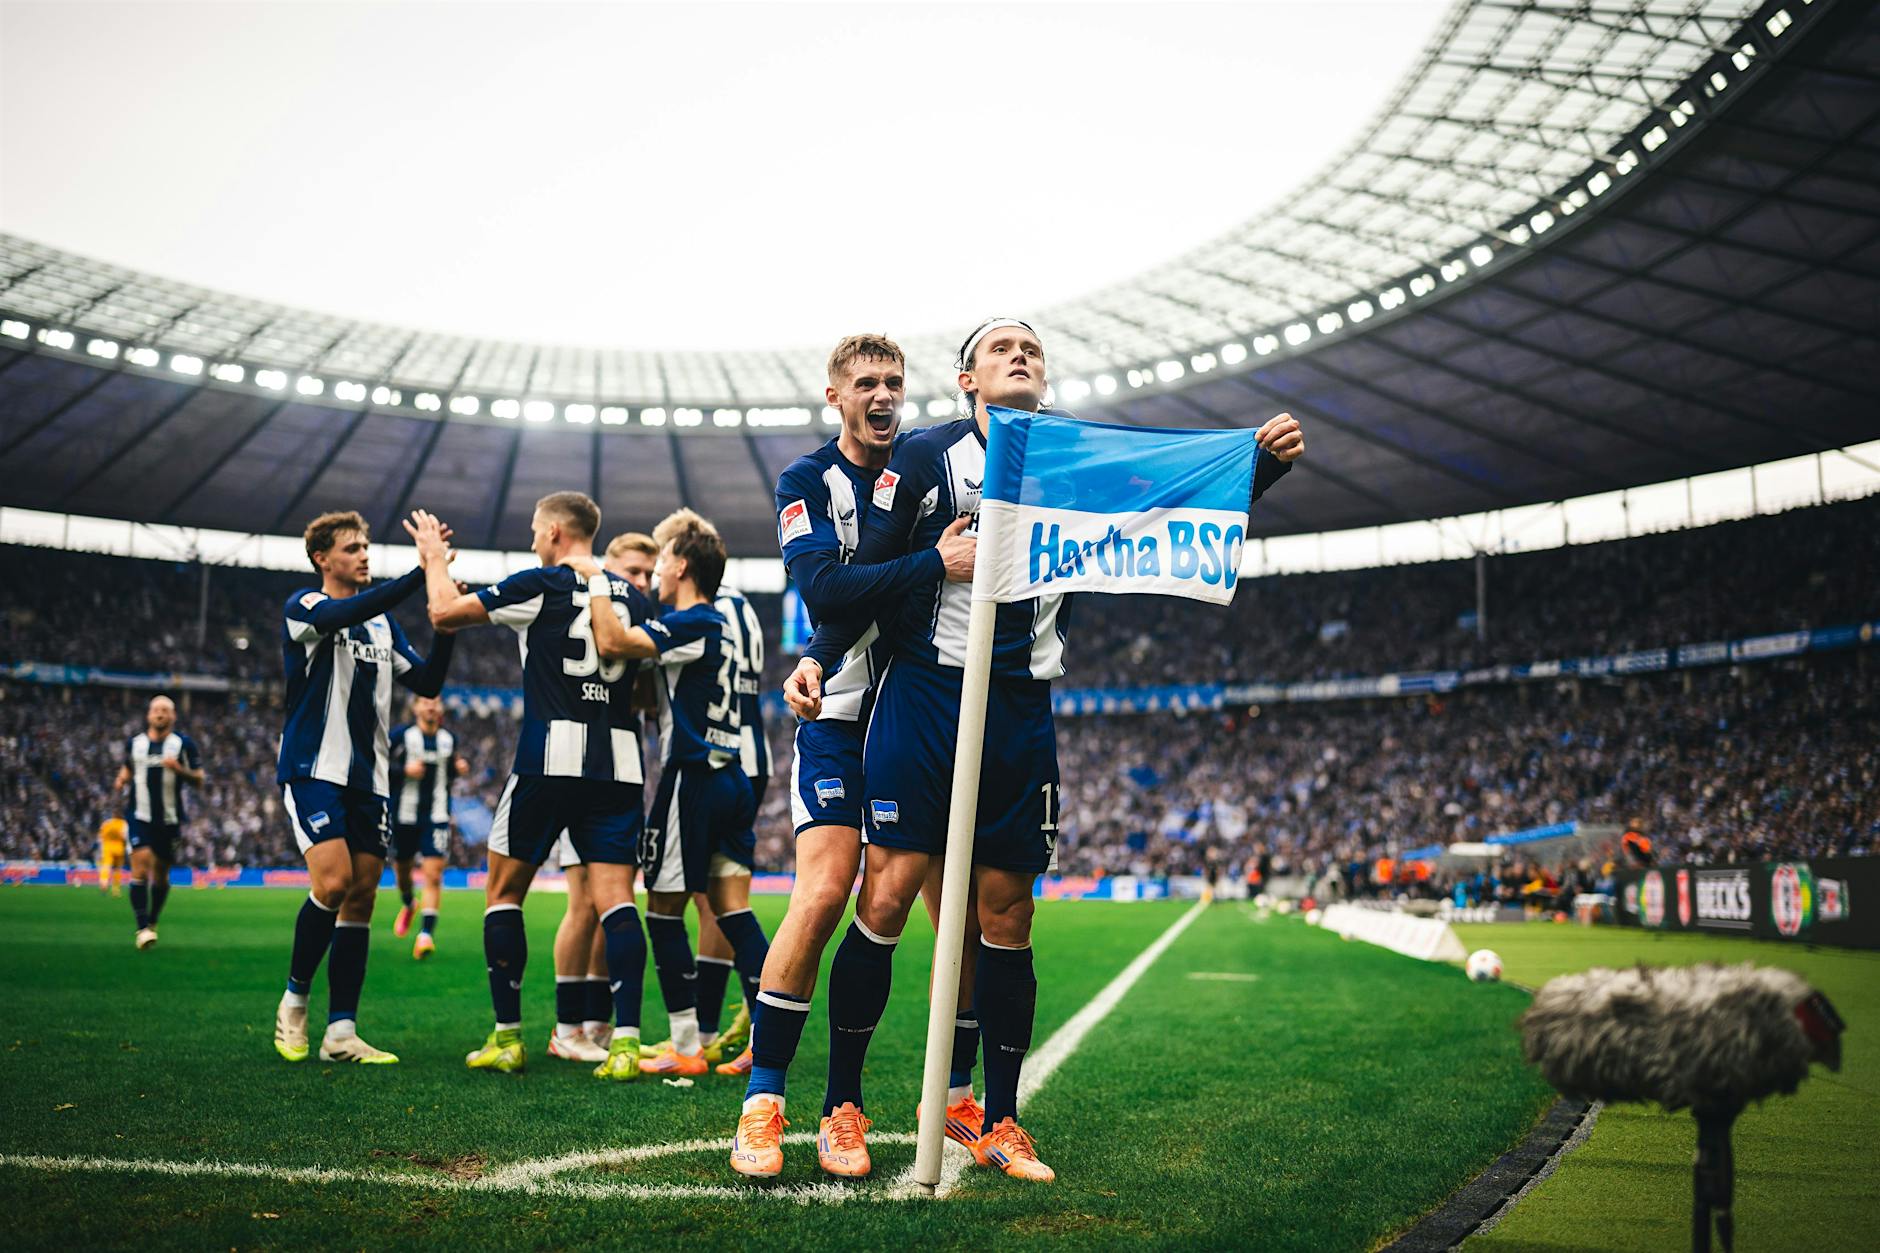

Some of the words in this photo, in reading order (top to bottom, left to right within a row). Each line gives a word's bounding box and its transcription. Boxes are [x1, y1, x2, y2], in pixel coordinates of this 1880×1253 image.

[1029, 521, 1161, 585] Hertha
[1167, 520, 1244, 590] BSC
[1696, 873, 1752, 921] BECK'S
